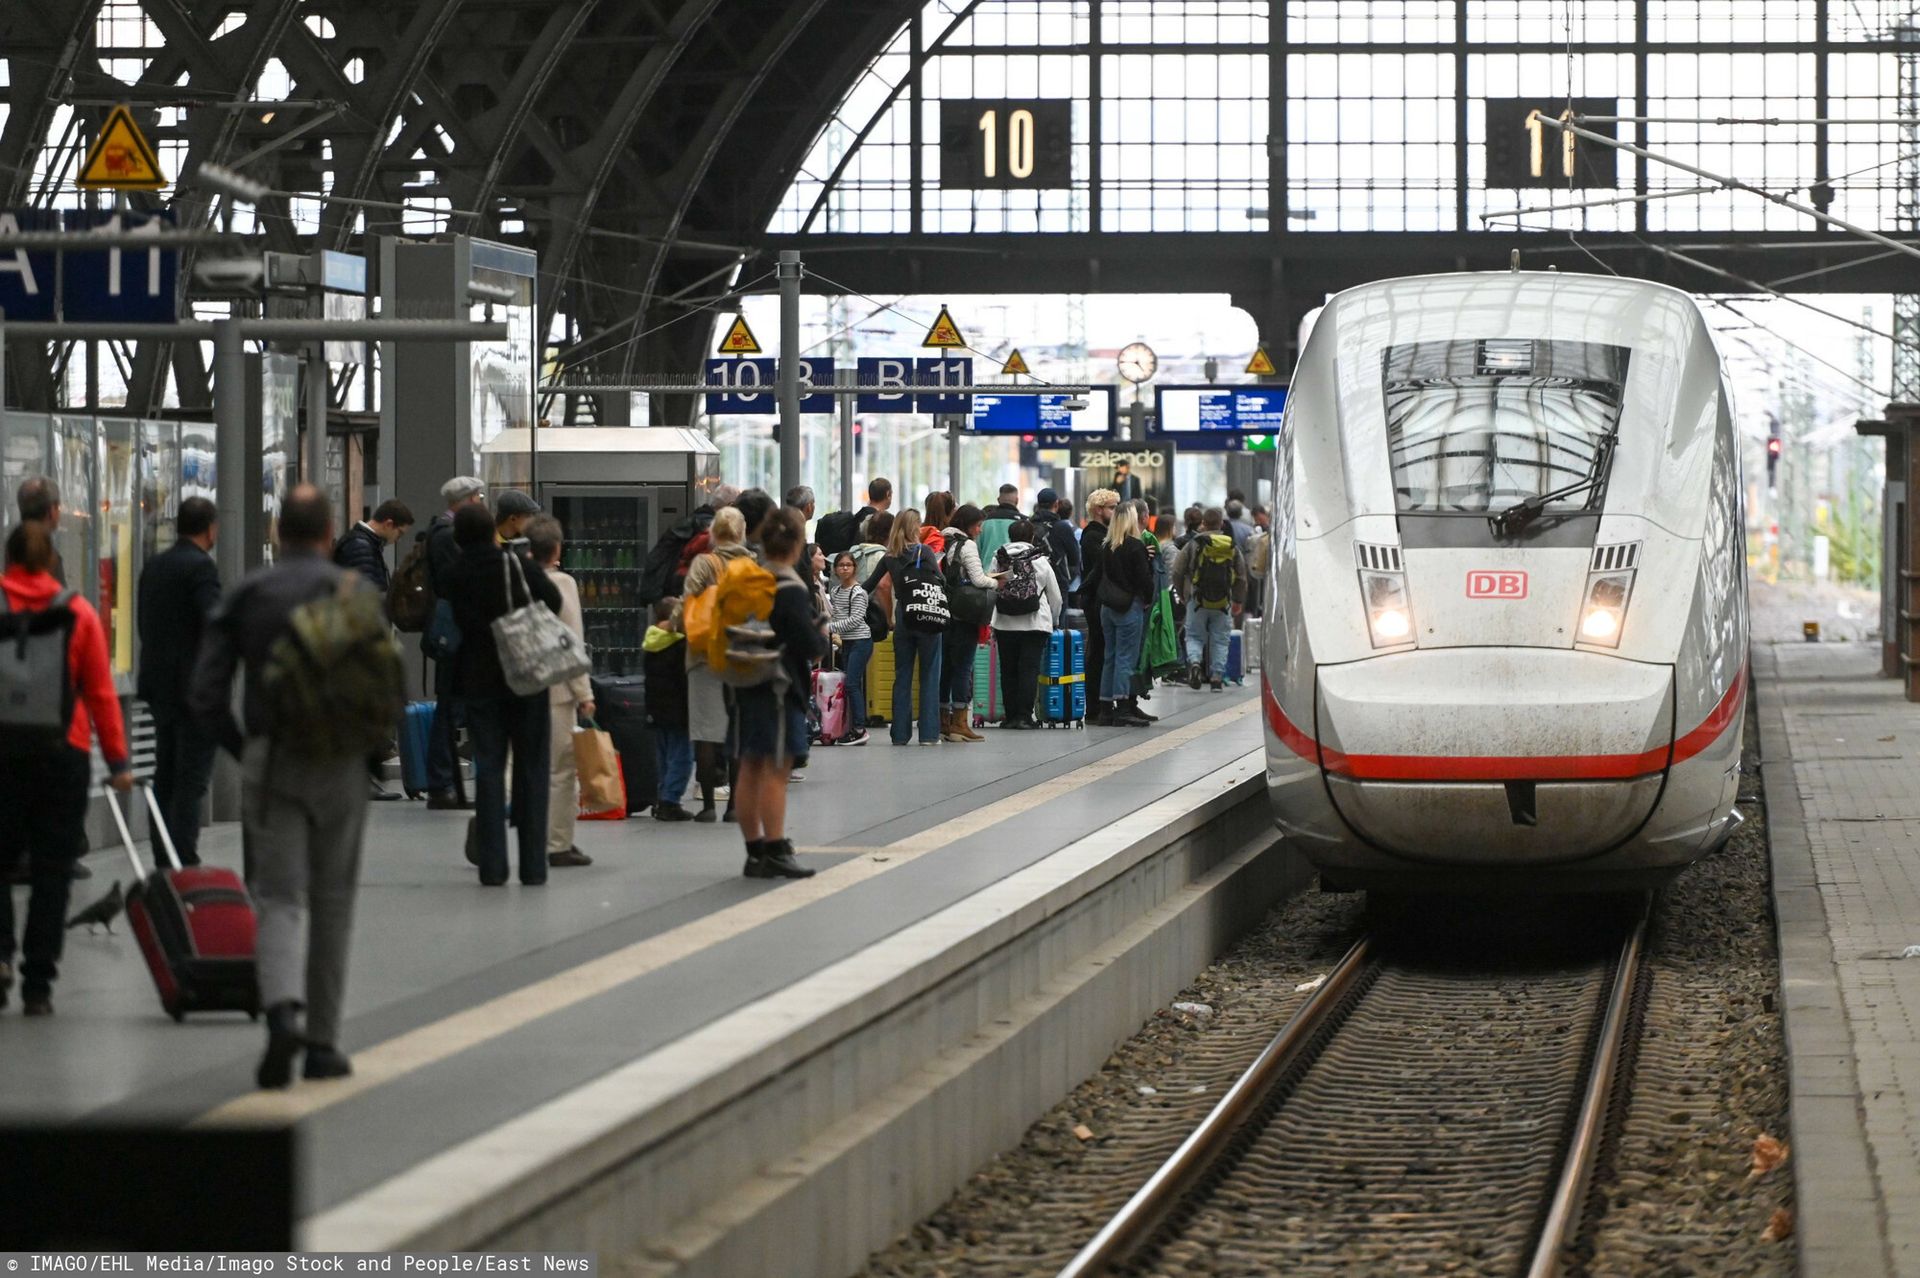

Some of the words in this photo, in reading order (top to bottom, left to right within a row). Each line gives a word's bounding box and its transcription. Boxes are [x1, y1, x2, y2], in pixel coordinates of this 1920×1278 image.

[978, 109, 1034, 179] 10
[1525, 109, 1575, 178] 11
[90, 213, 162, 296] 11
[712, 360, 761, 402] 10
[877, 360, 906, 401] B
[930, 360, 966, 401] 11
[1079, 449, 1165, 467] zalando
[921, 582, 943, 593] THE
[926, 597, 941, 606] OF
[1473, 574, 1521, 595] DB
